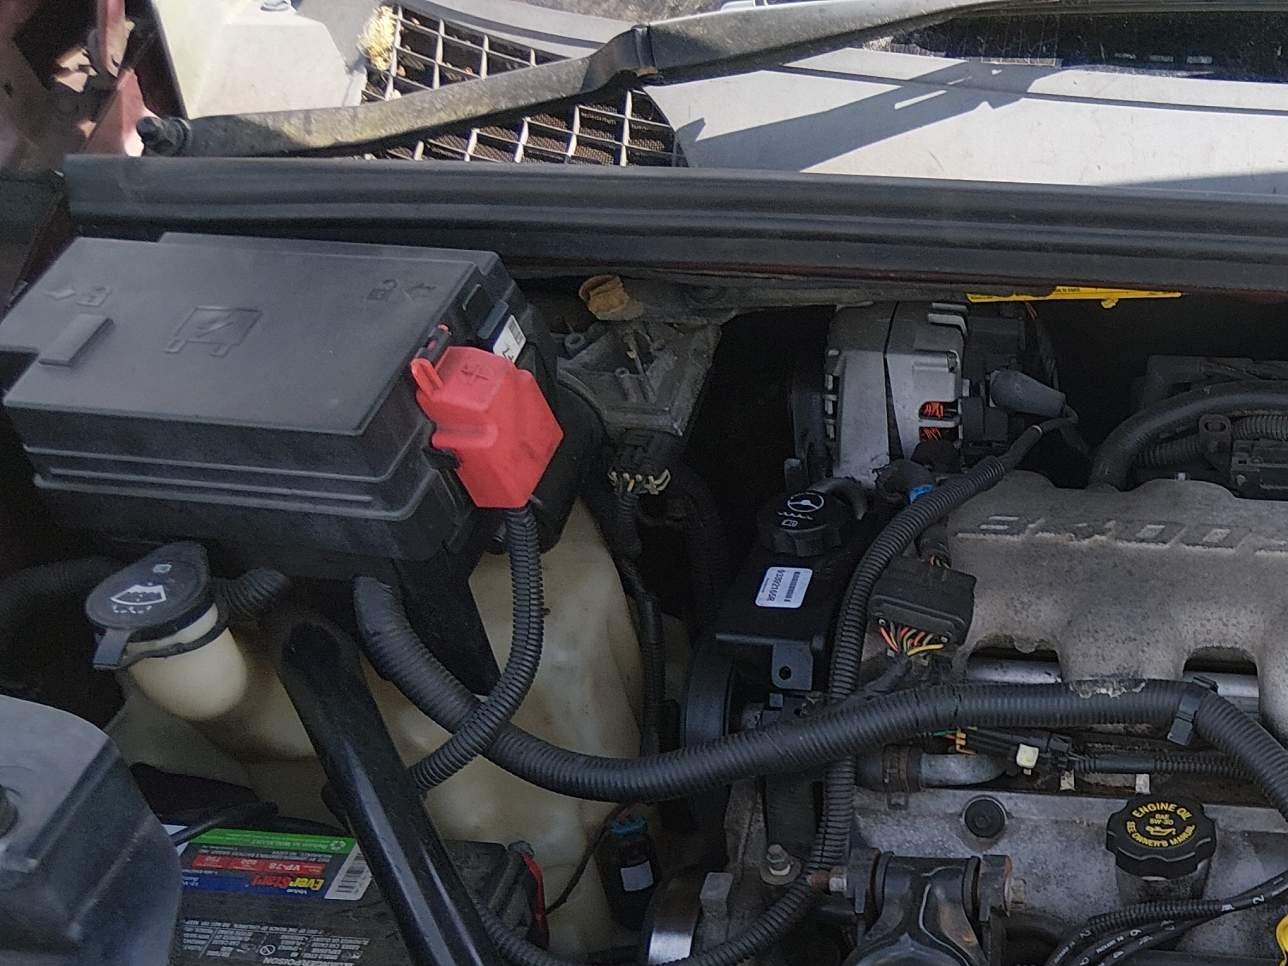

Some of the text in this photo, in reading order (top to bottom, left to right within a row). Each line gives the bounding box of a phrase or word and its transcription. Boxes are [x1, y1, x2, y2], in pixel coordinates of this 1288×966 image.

[1131, 802, 1193, 821] ENGINE OIL
[1126, 820, 1196, 848] SEE OWNER'S MANUAL
[252, 874, 325, 891] EverStart
